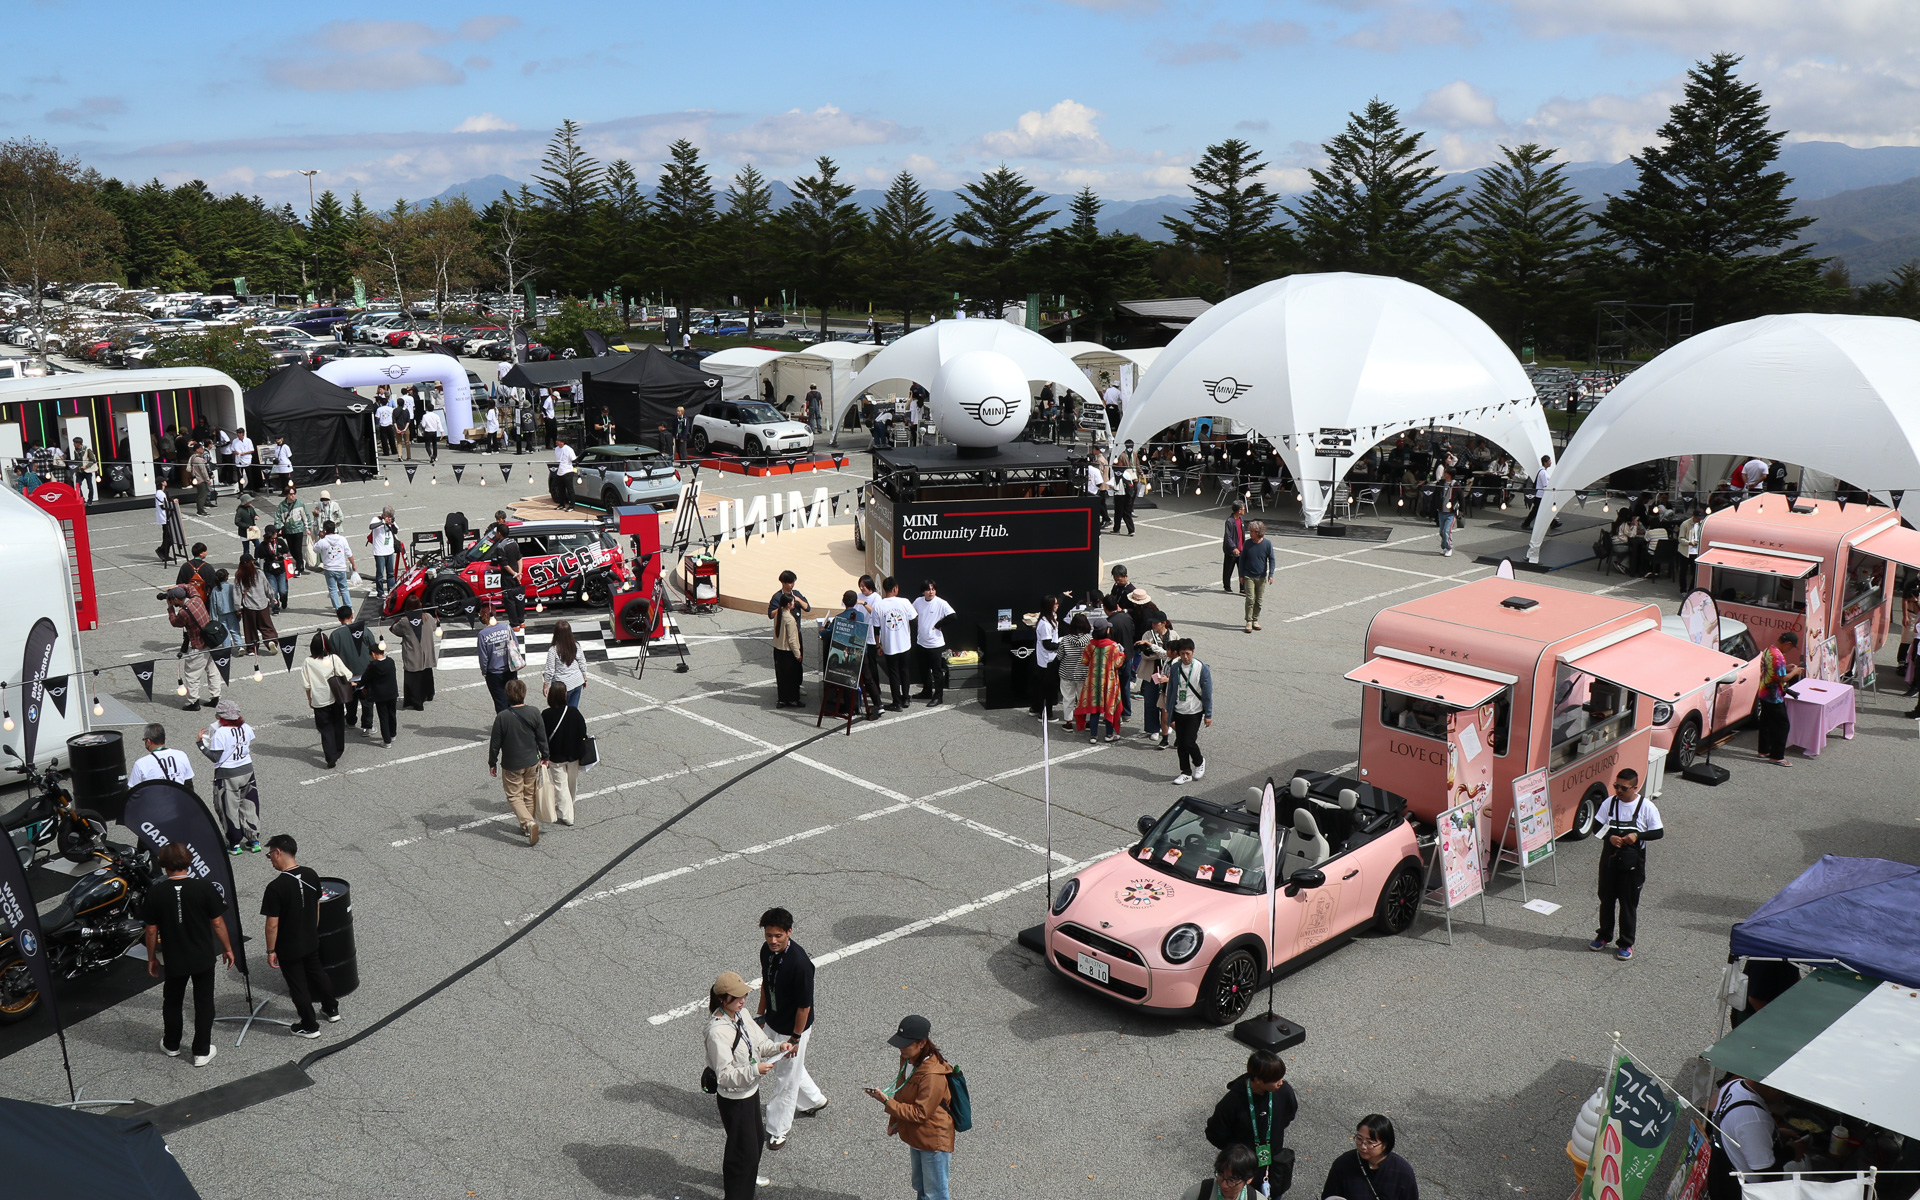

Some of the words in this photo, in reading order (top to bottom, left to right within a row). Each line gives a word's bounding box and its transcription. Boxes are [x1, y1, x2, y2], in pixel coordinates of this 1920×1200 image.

[1105, 335, 1127, 343] トイレ
[1216, 386, 1235, 395] MINI
[982, 407, 1005, 416] MINI
[903, 514, 938, 527] MINI
[903, 526, 977, 541] Community
[979, 524, 1009, 538] Hub.
[528, 545, 594, 587] SYCG
[487, 576, 499, 586] 34
[1750, 615, 1803, 633] CHURRO
[1429, 646, 1469, 659] TKKX
[31, 671, 39, 699] BMW
[1390, 740, 1426, 762] LOVE
[1562, 769, 1585, 792] LOVE
[1585, 752, 1620, 780] CHURRO
[1619, 1067, 1671, 1124] フルーツ
[1614, 1094, 1660, 1138] サンド
